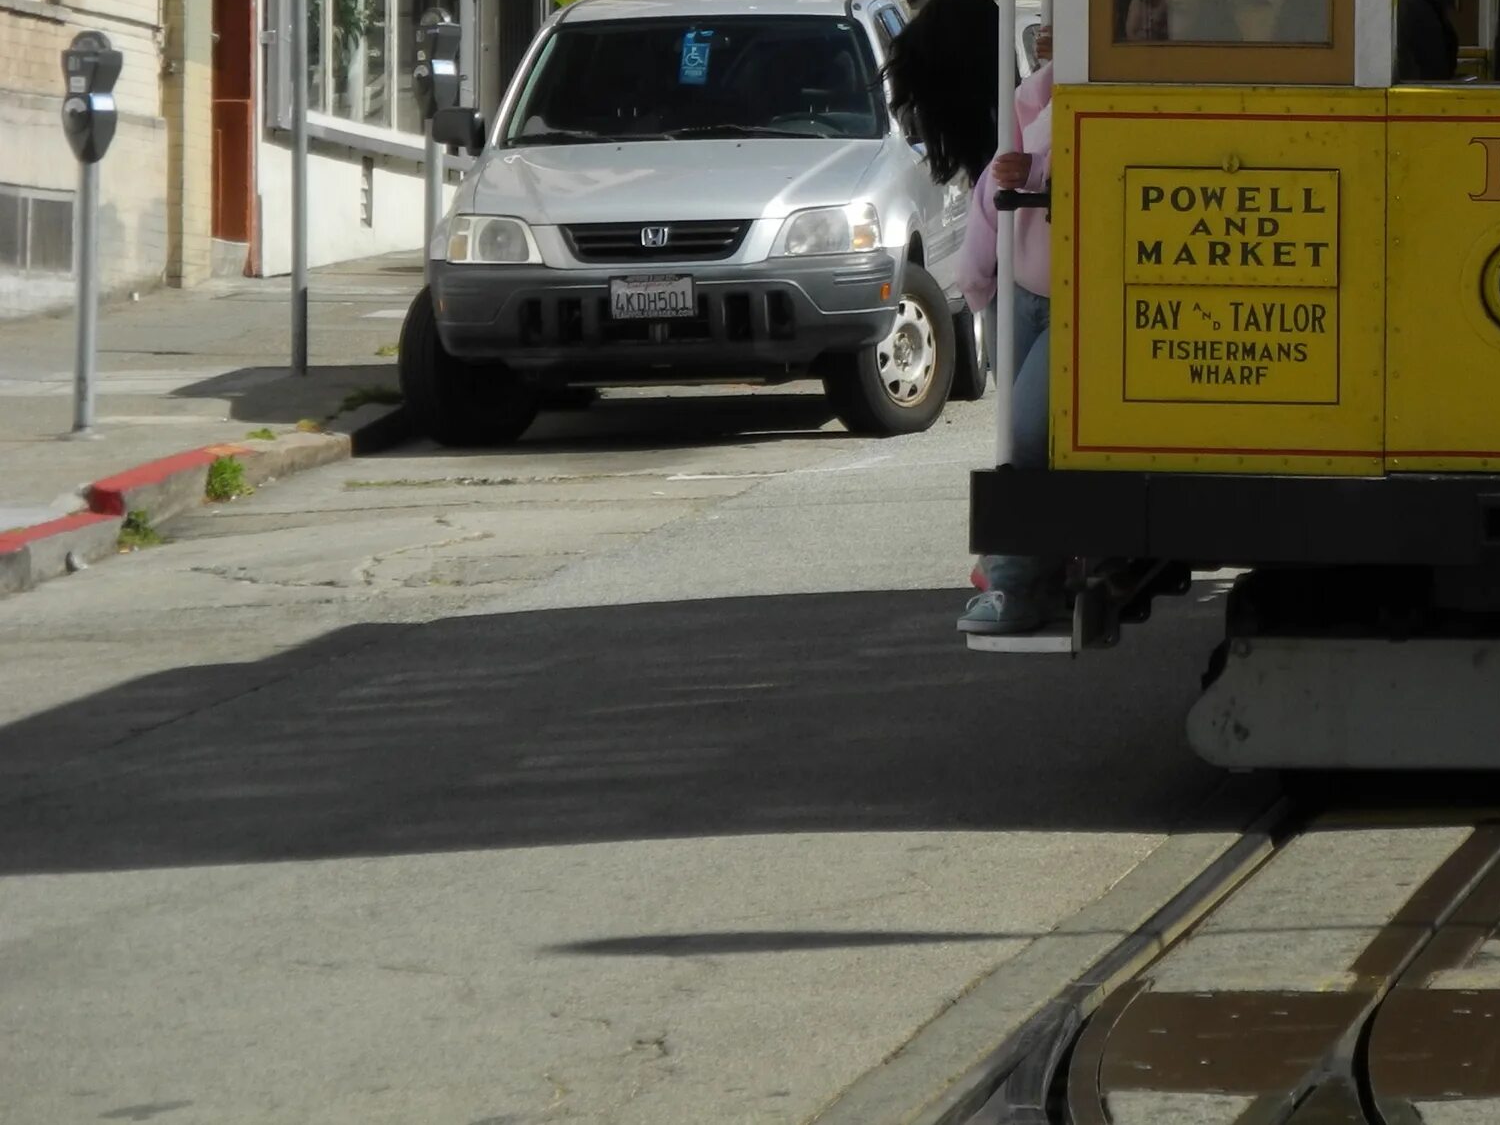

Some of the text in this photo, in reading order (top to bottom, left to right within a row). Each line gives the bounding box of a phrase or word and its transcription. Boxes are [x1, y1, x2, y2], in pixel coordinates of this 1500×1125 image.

[1140, 186, 1326, 213] POWELL
[1190, 217, 1280, 237] AND
[1136, 241, 1329, 267] MARKET
[615, 290, 689, 312] 4KDH501
[1135, 300, 1327, 333] BAY AND TAYLOR
[1151, 340, 1308, 362] FISHERMANS
[1189, 365, 1269, 385] WHARF
